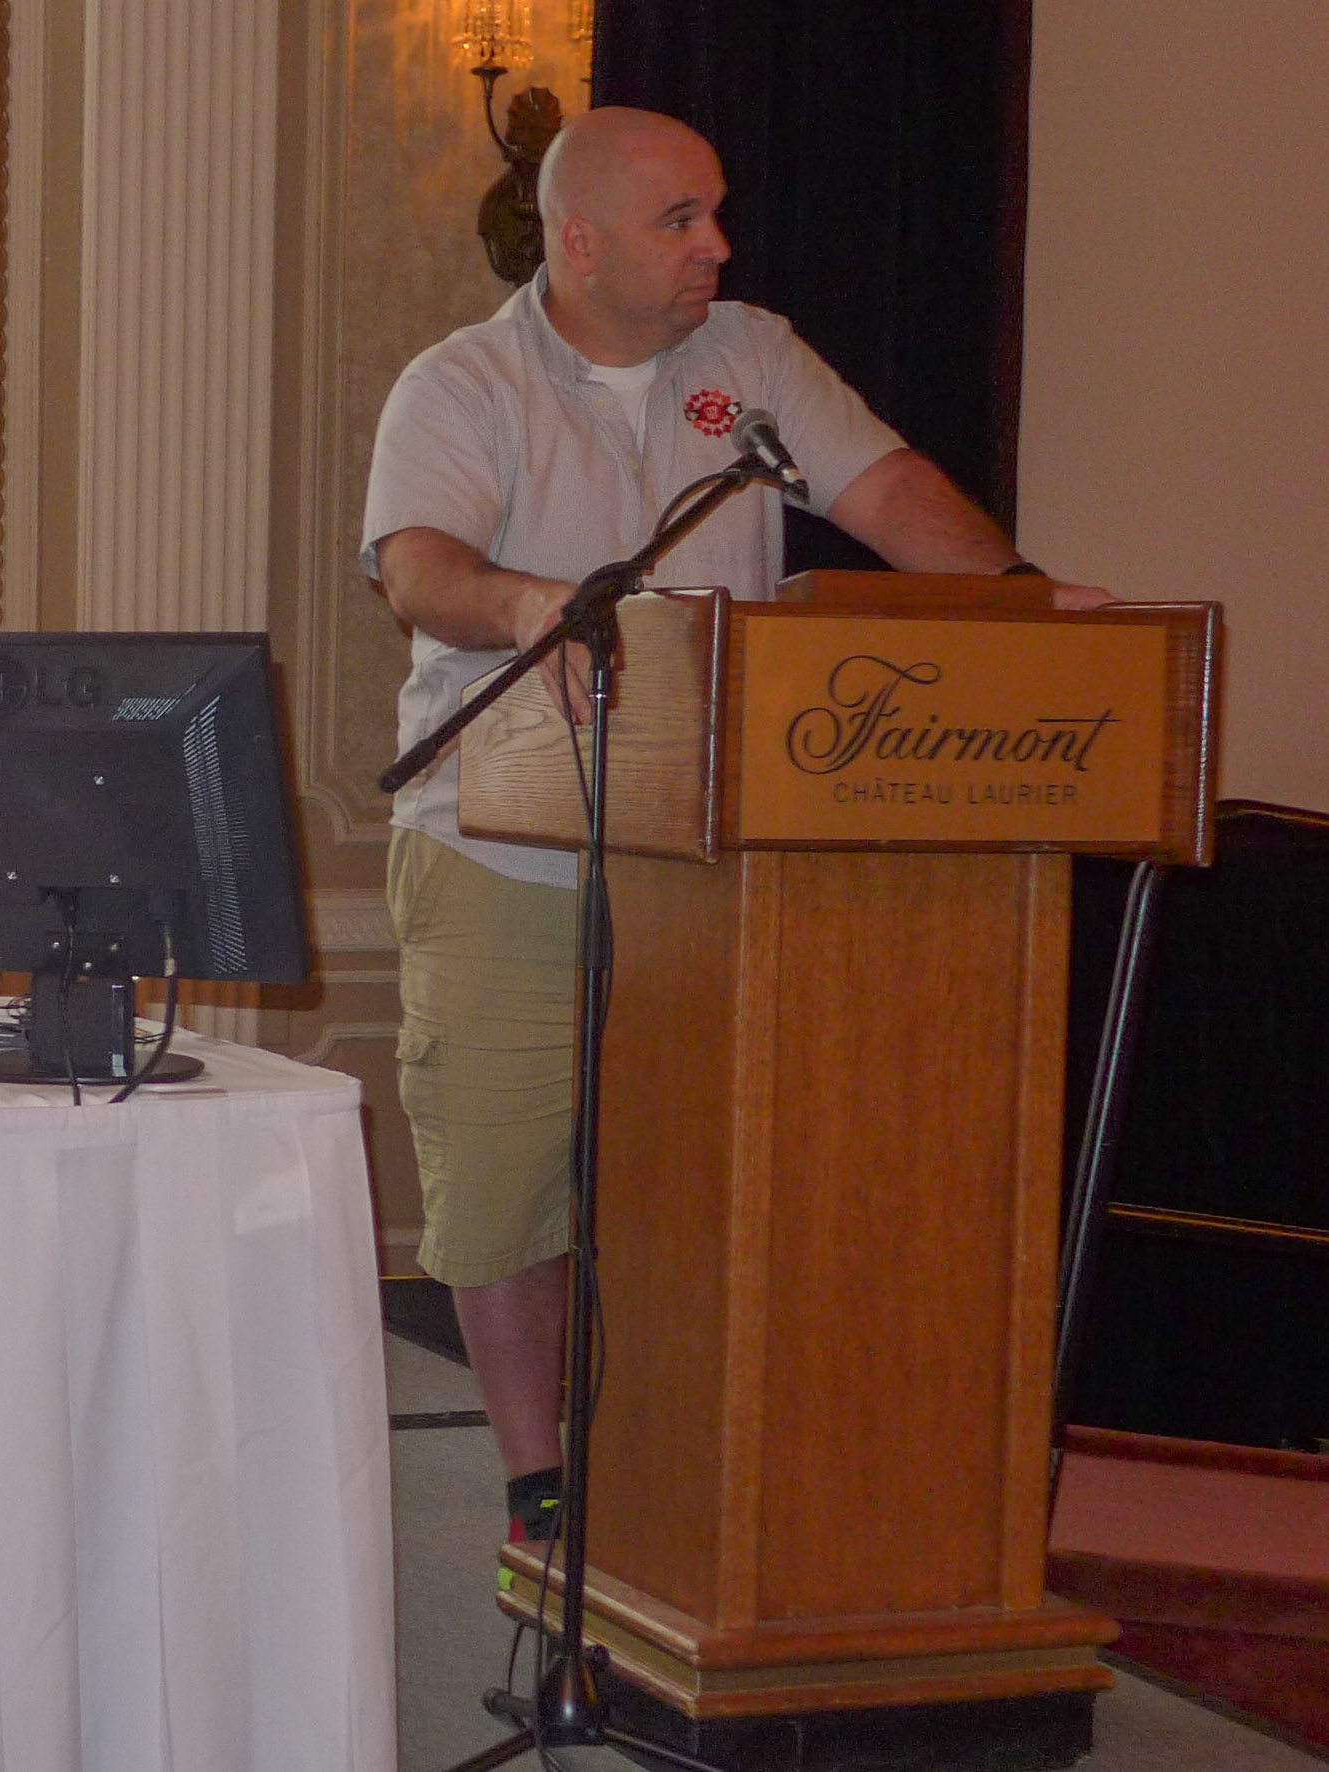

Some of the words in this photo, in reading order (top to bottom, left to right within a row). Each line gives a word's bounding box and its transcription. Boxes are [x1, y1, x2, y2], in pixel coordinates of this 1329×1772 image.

[35, 665, 102, 708] LG
[786, 655, 1122, 775] Fairmont
[833, 777, 954, 804] CHÂTEAU
[967, 783, 1078, 805] LAURIER
